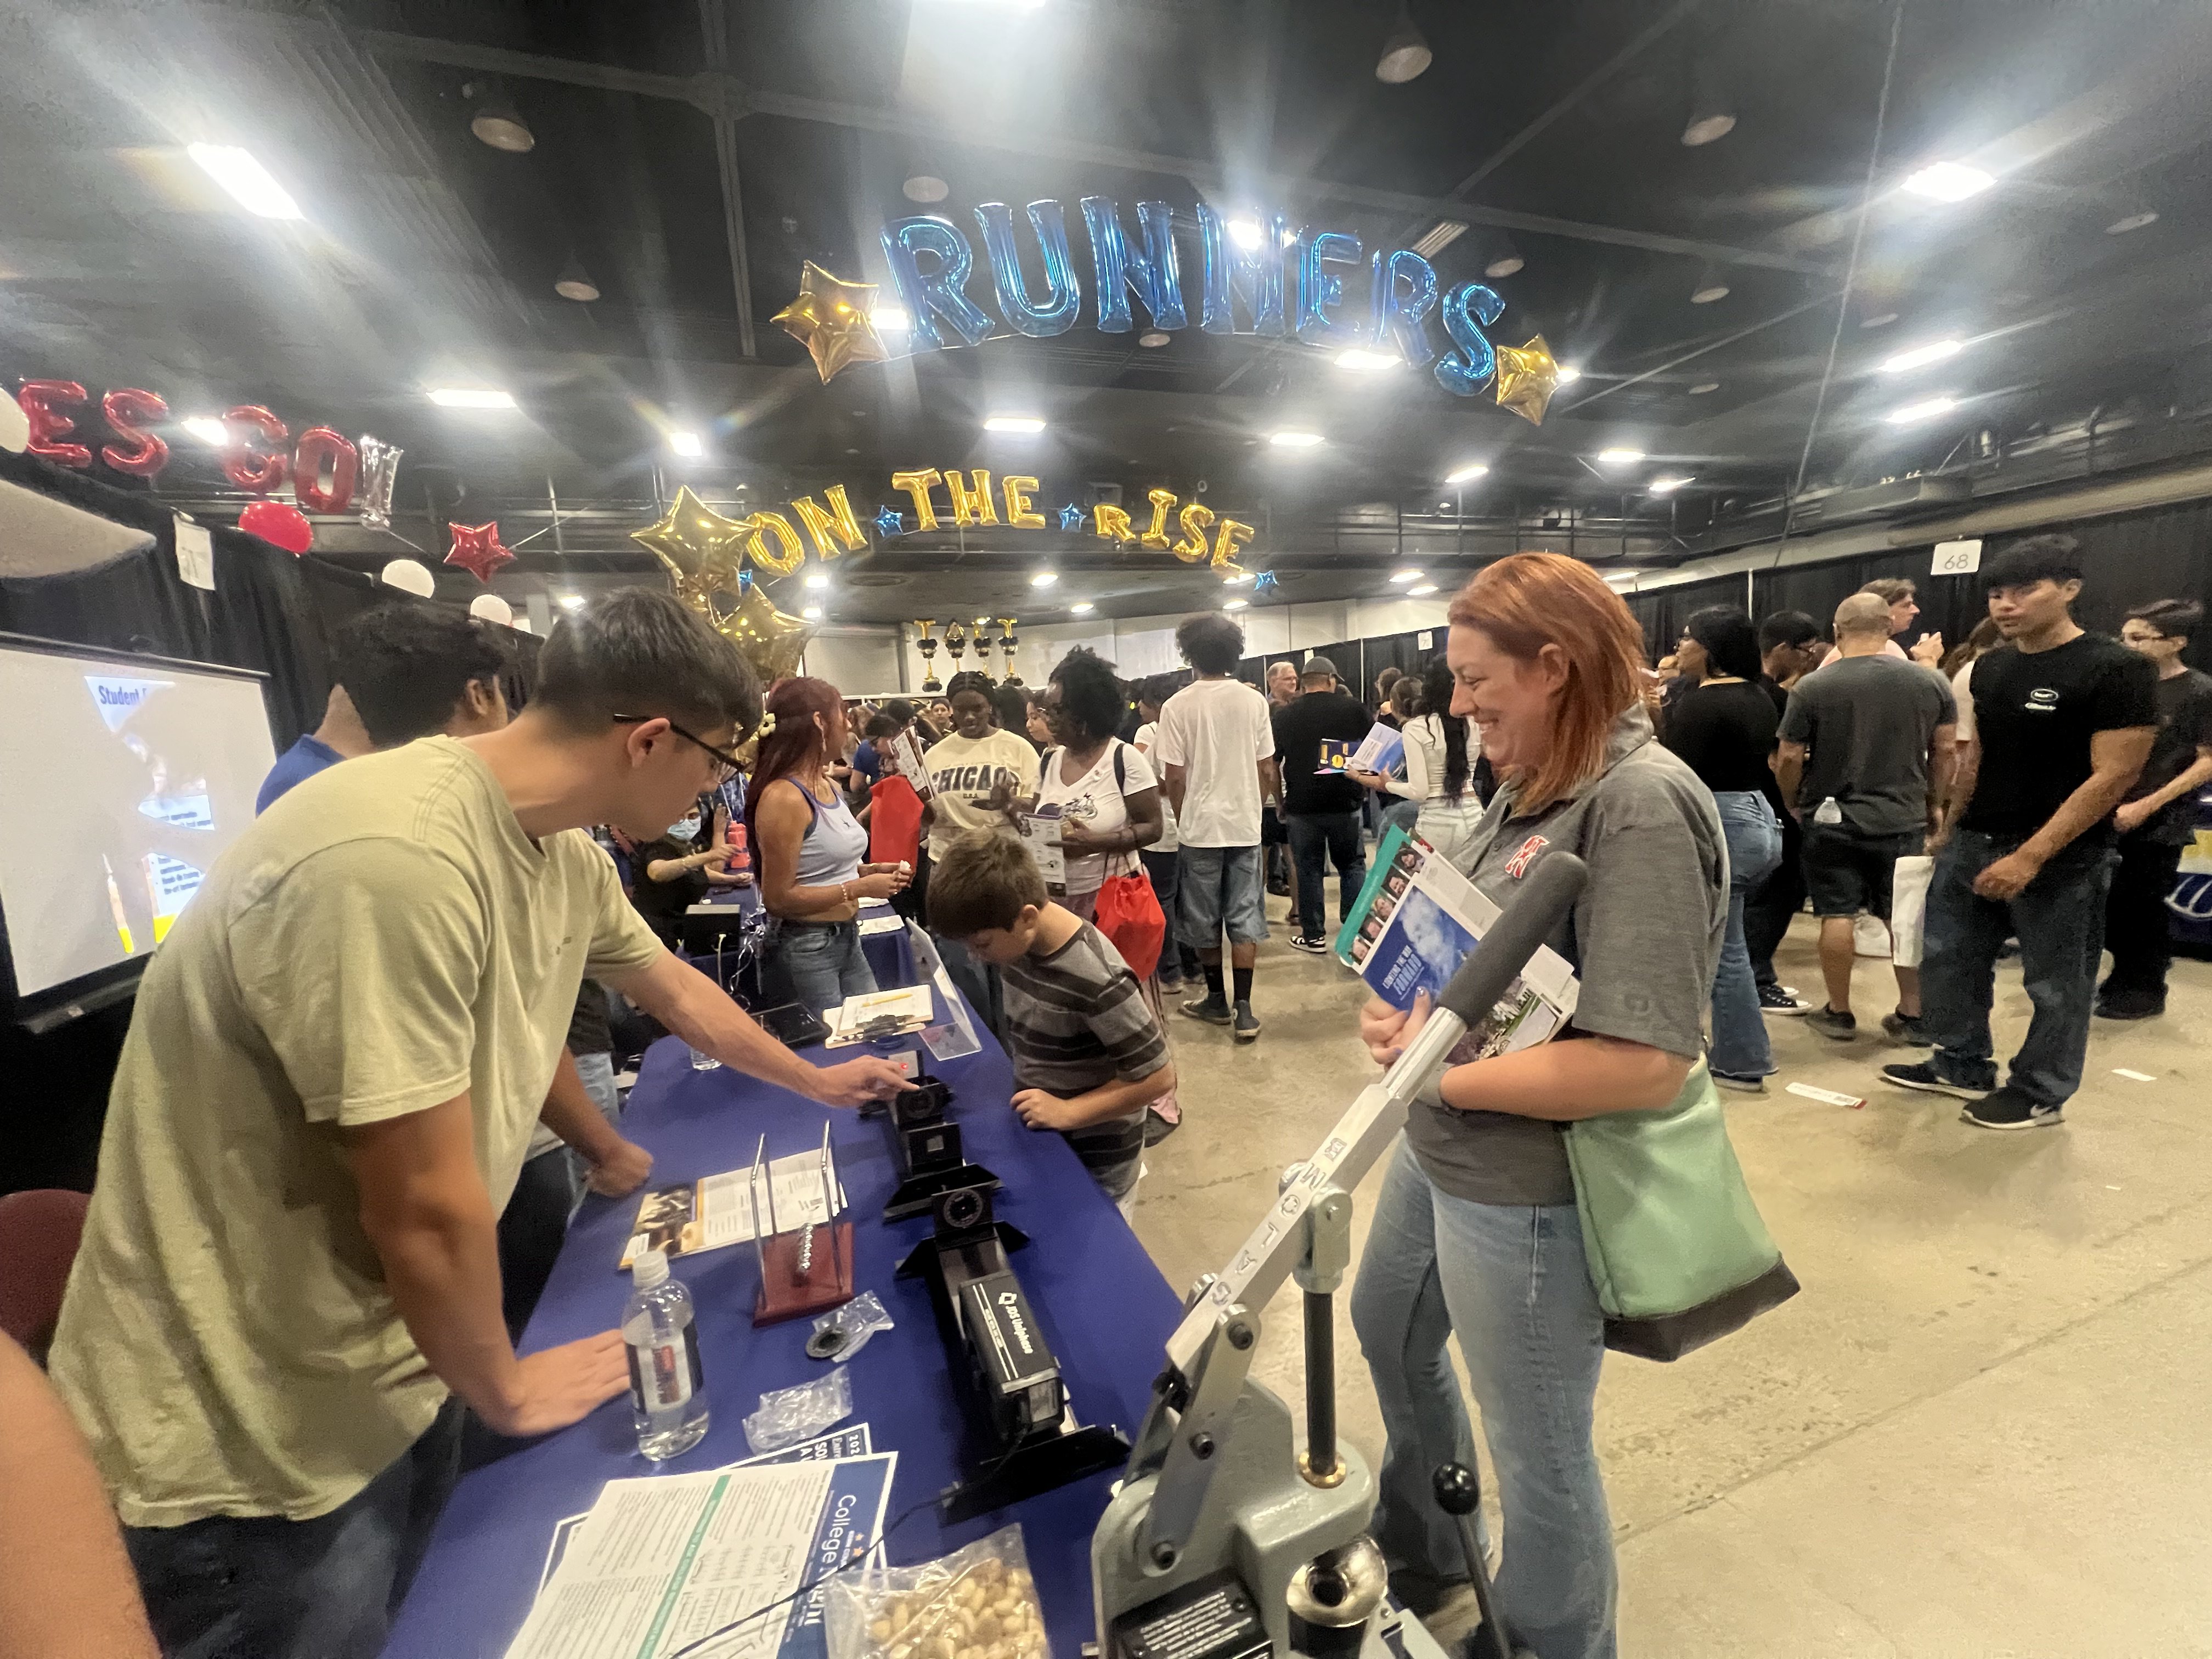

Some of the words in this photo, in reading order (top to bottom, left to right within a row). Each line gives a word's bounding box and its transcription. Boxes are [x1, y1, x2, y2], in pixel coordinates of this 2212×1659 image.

[879, 196, 1506, 396] RUNNERS
[746, 484, 868, 577] ON
[892, 468, 1045, 531] THE
[1094, 489, 1255, 582] RISE
[1944, 554, 1968, 569] 68
[98, 685, 140, 705] Student
[1005, 1306, 1020, 1319] JDS
[1012, 1318, 1034, 1354] Uniphase
[848, 1434, 860, 1455] 202
[822, 1495, 856, 1564] College
